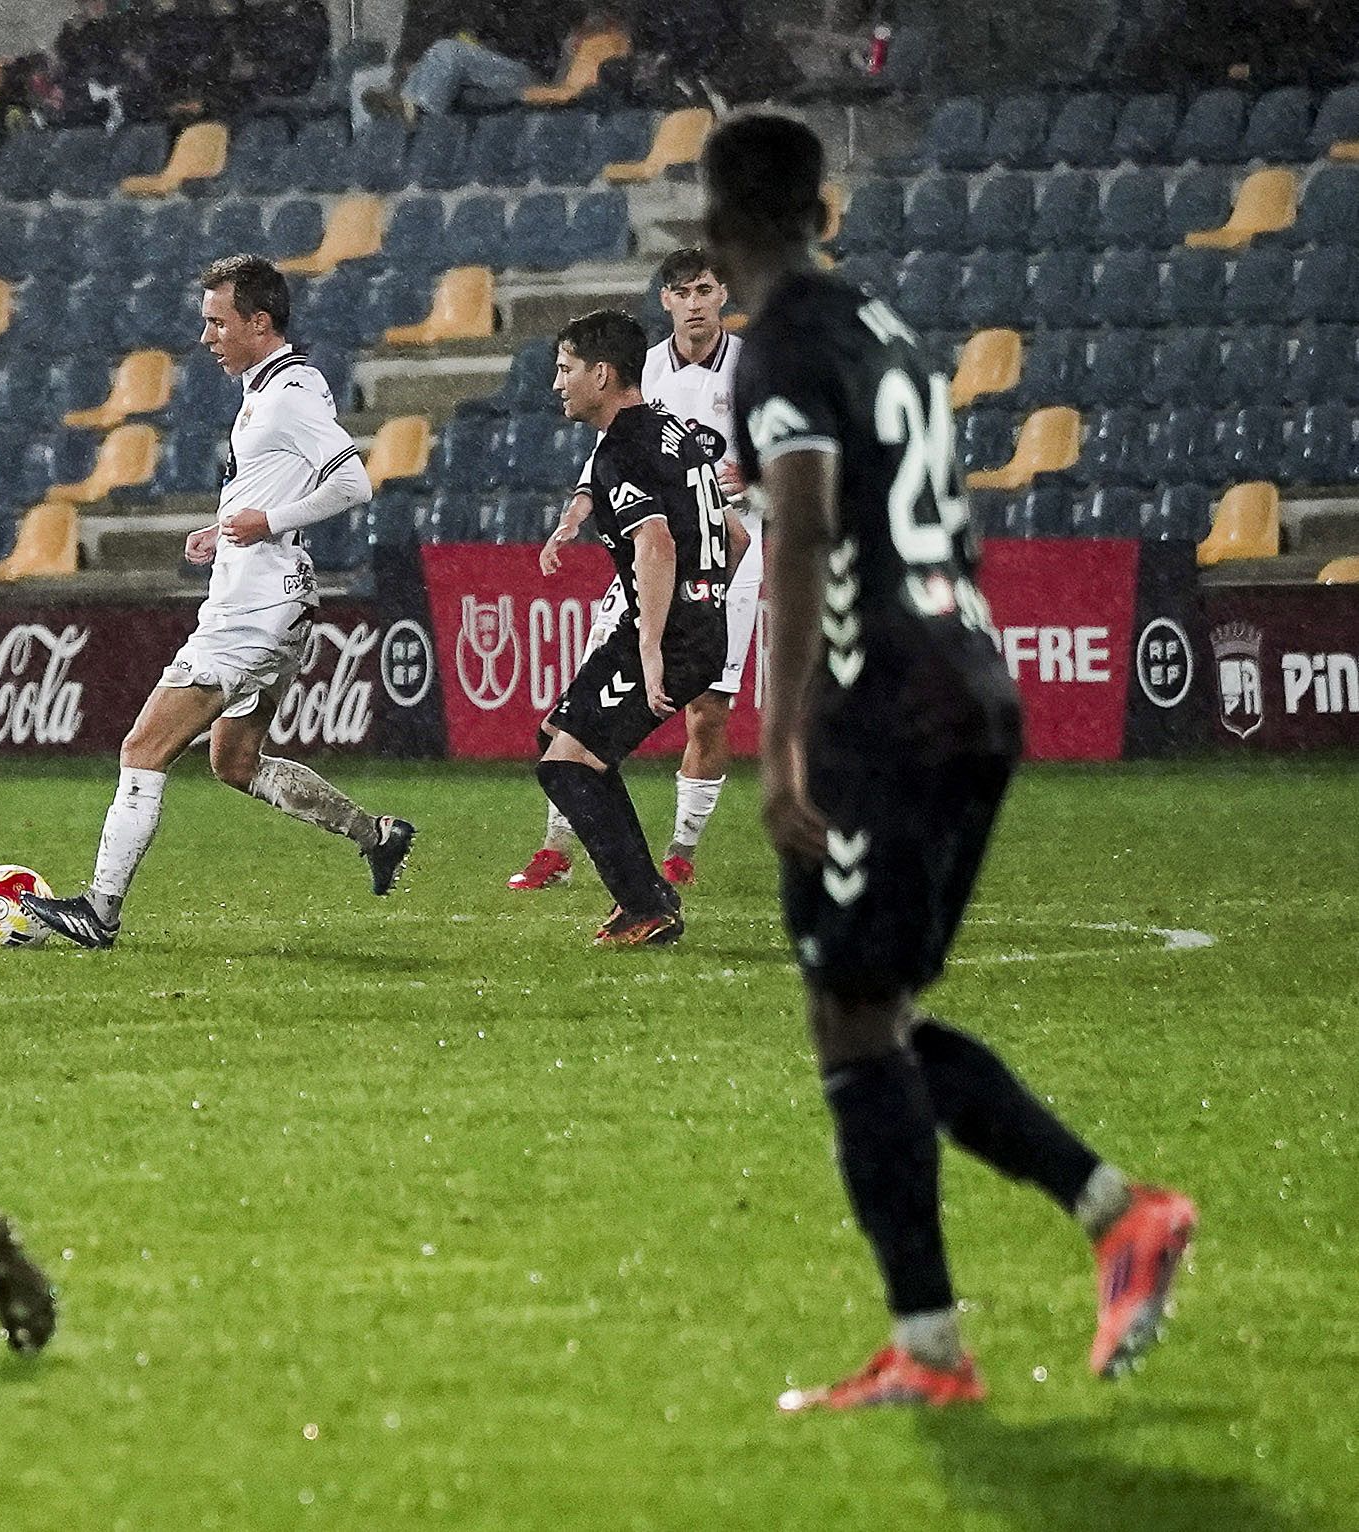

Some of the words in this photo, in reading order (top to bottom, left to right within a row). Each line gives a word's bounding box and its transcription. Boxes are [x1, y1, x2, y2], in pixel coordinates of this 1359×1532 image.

[661, 415, 692, 459] TONI
[874, 368, 970, 565] 24
[686, 463, 727, 571] 19
[602, 582, 621, 613] 6
[529, 598, 599, 710] CO
[1002, 626, 1111, 682] FRE
